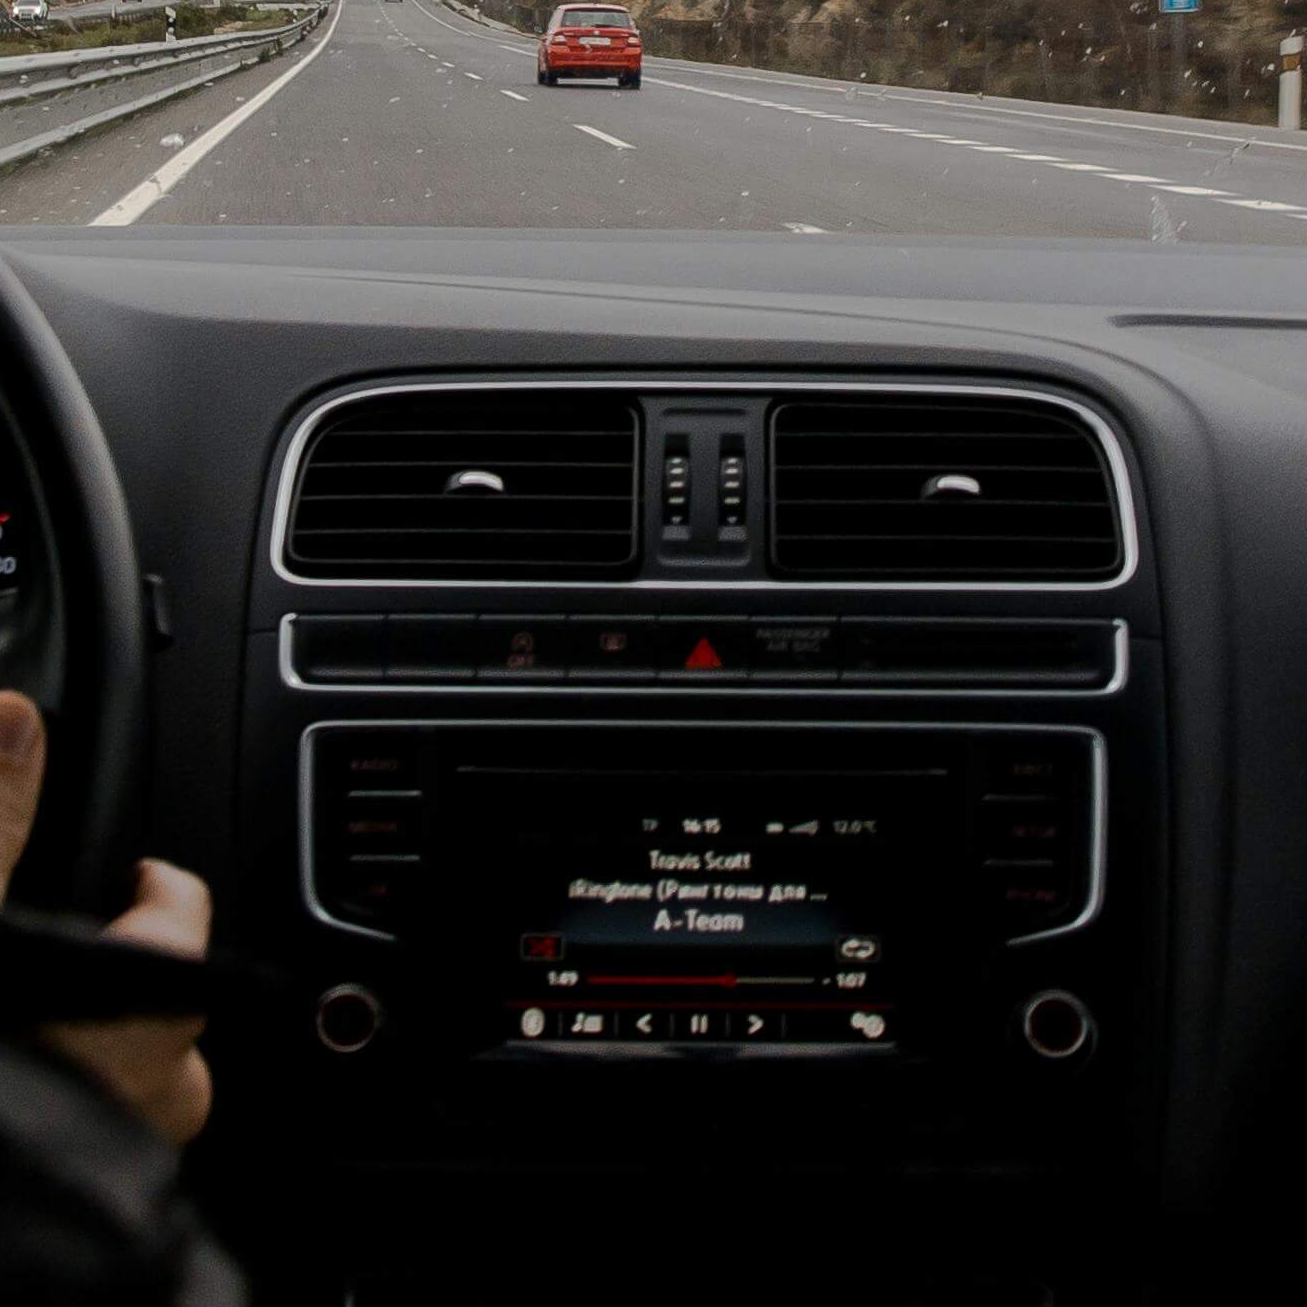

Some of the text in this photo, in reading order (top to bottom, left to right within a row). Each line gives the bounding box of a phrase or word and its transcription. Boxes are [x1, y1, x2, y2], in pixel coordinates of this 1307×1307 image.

[649, 849, 751, 871] Travis Scott
[652, 908, 744, 932] A-Team
